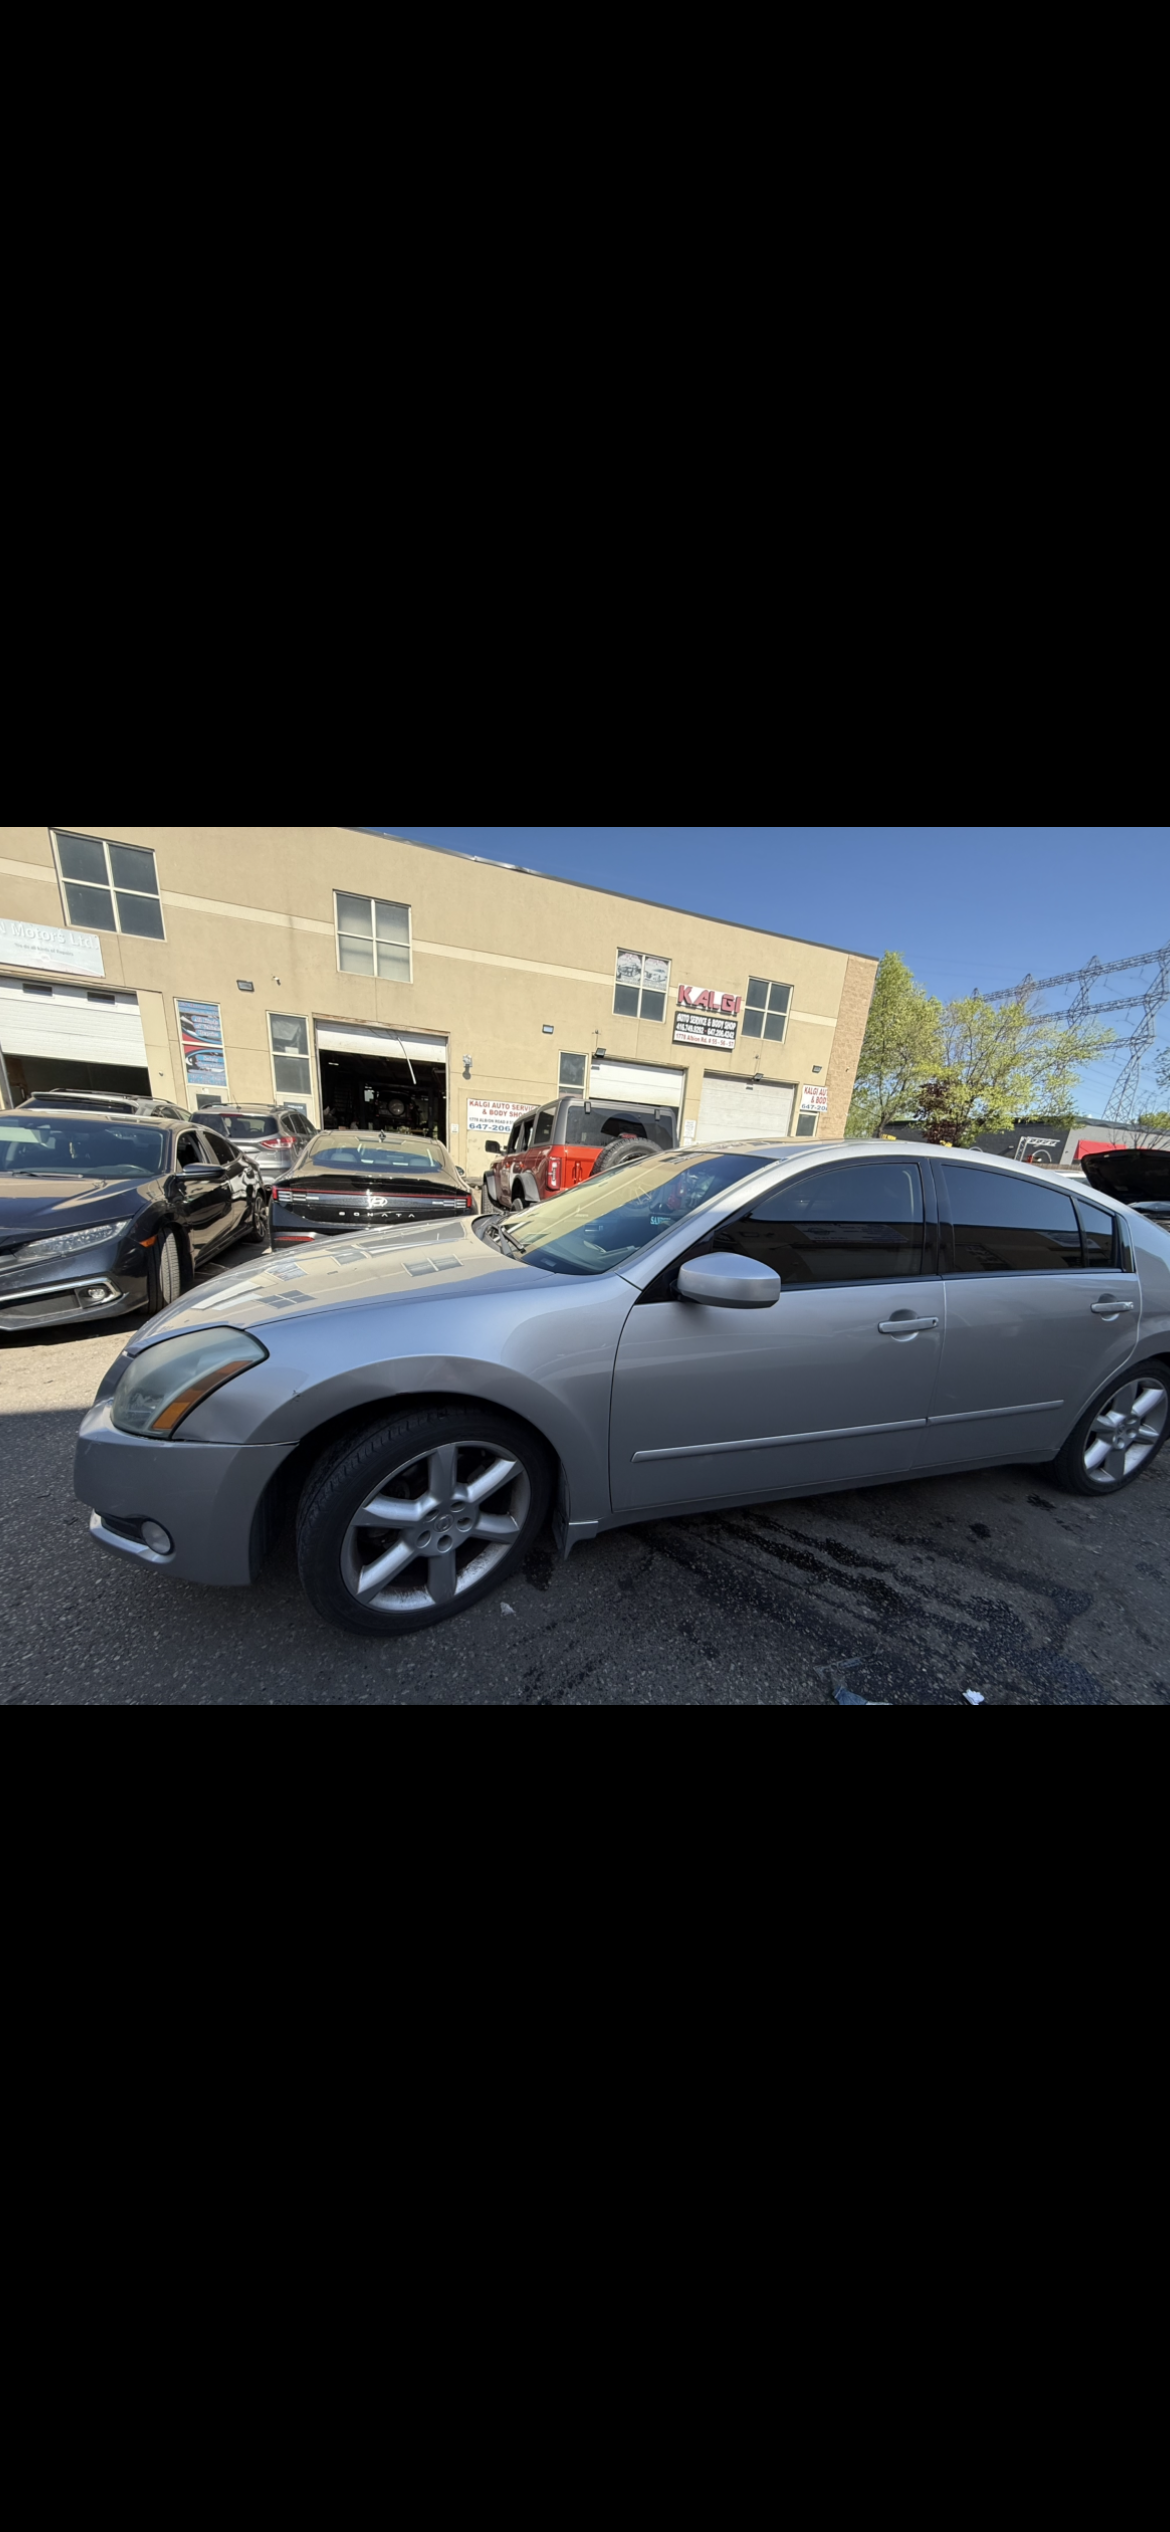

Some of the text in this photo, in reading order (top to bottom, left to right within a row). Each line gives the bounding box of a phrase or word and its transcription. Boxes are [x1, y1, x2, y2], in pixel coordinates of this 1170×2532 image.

[11, 923, 66, 944] Motors
[677, 985, 742, 1013] KALGI
[677, 1013, 690, 1023] AUTO
[690, 1016, 707, 1026] SERVICE
[712, 1019, 724, 1029] BODY
[724, 1021, 737, 1031] SHOP
[687, 1034, 700, 1043] Albion
[804, 1087, 827, 1096] KALGI AU
[469, 1100, 535, 1112] KALGI AUTO SERVIC
[489, 1109, 508, 1117] BODY
